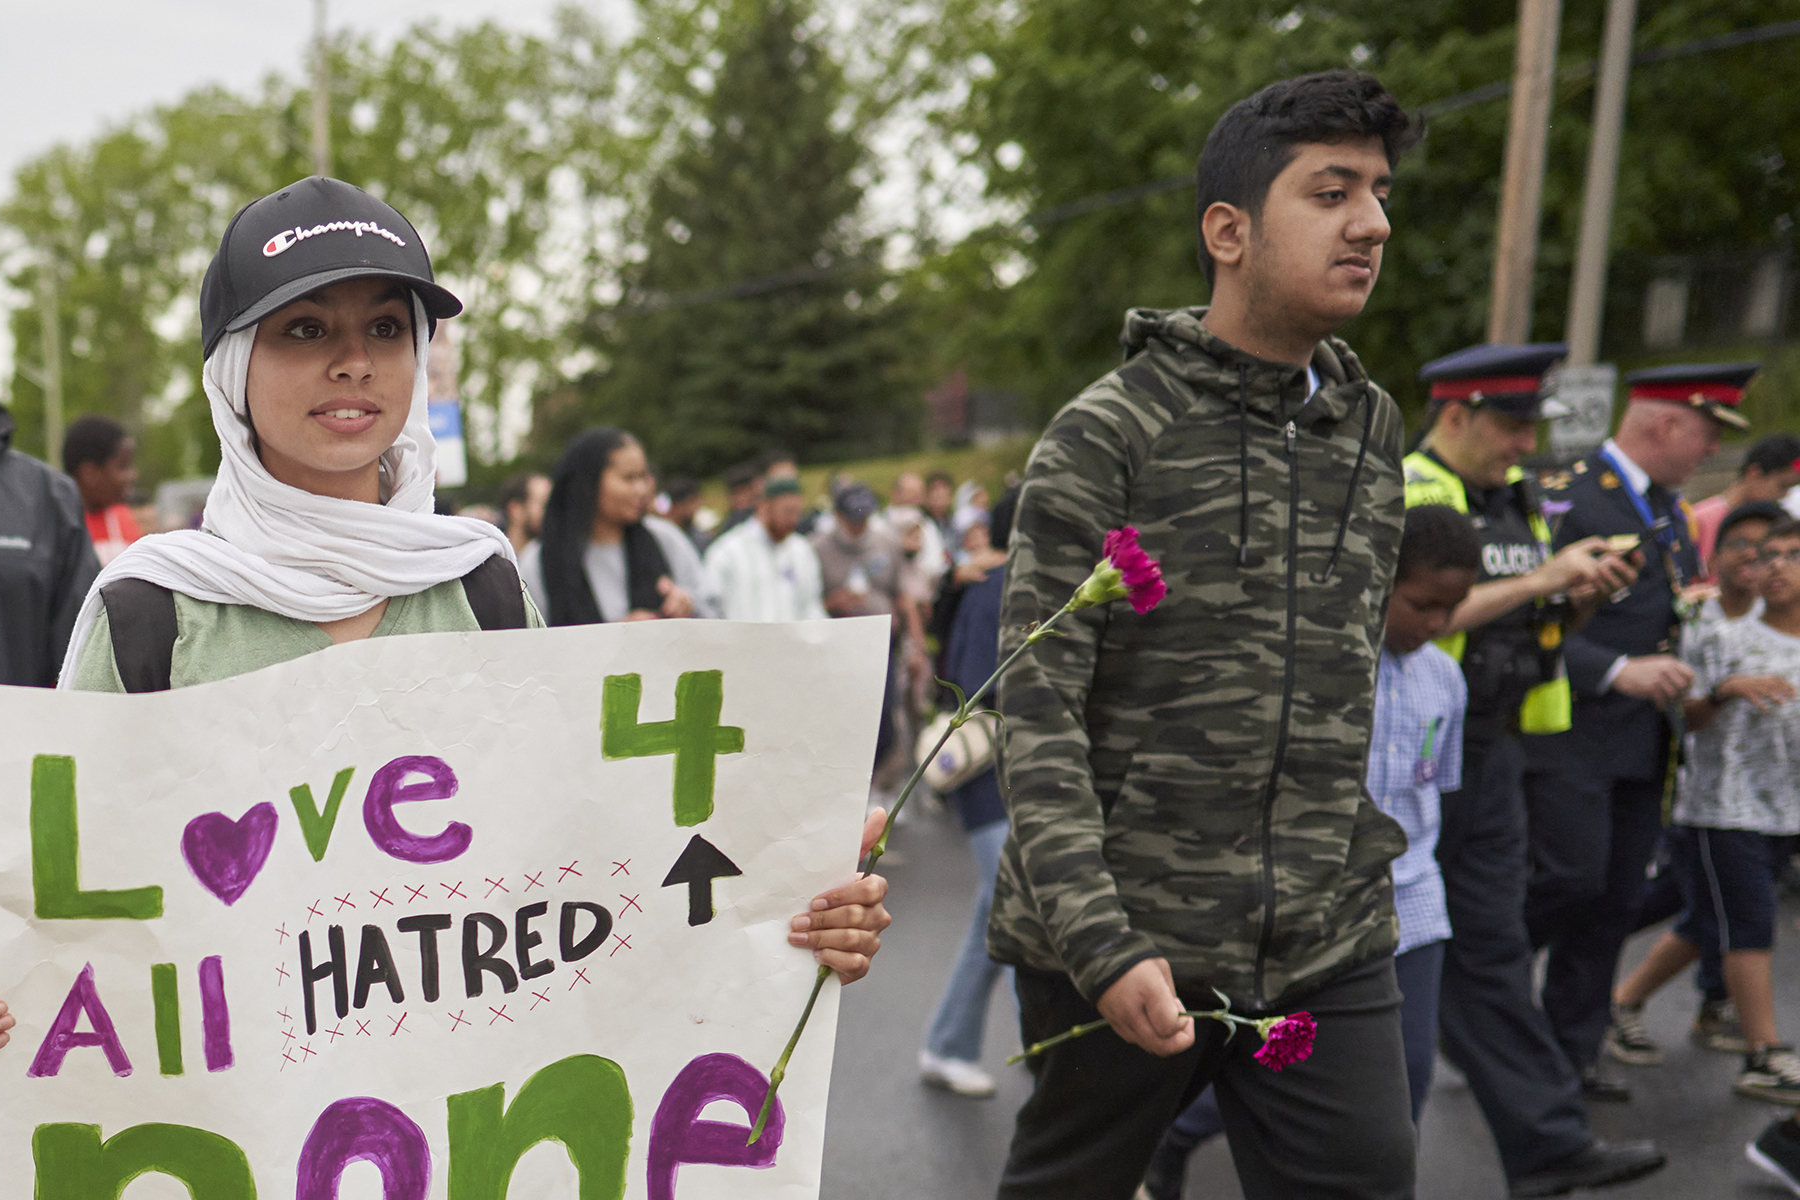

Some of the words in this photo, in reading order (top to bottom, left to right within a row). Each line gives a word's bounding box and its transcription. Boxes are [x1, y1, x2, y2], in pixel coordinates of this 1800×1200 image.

[262, 221, 406, 257] Champion
[600, 669, 745, 828] 4
[26, 954, 235, 1079] All
[299, 900, 614, 1036] HATRED
